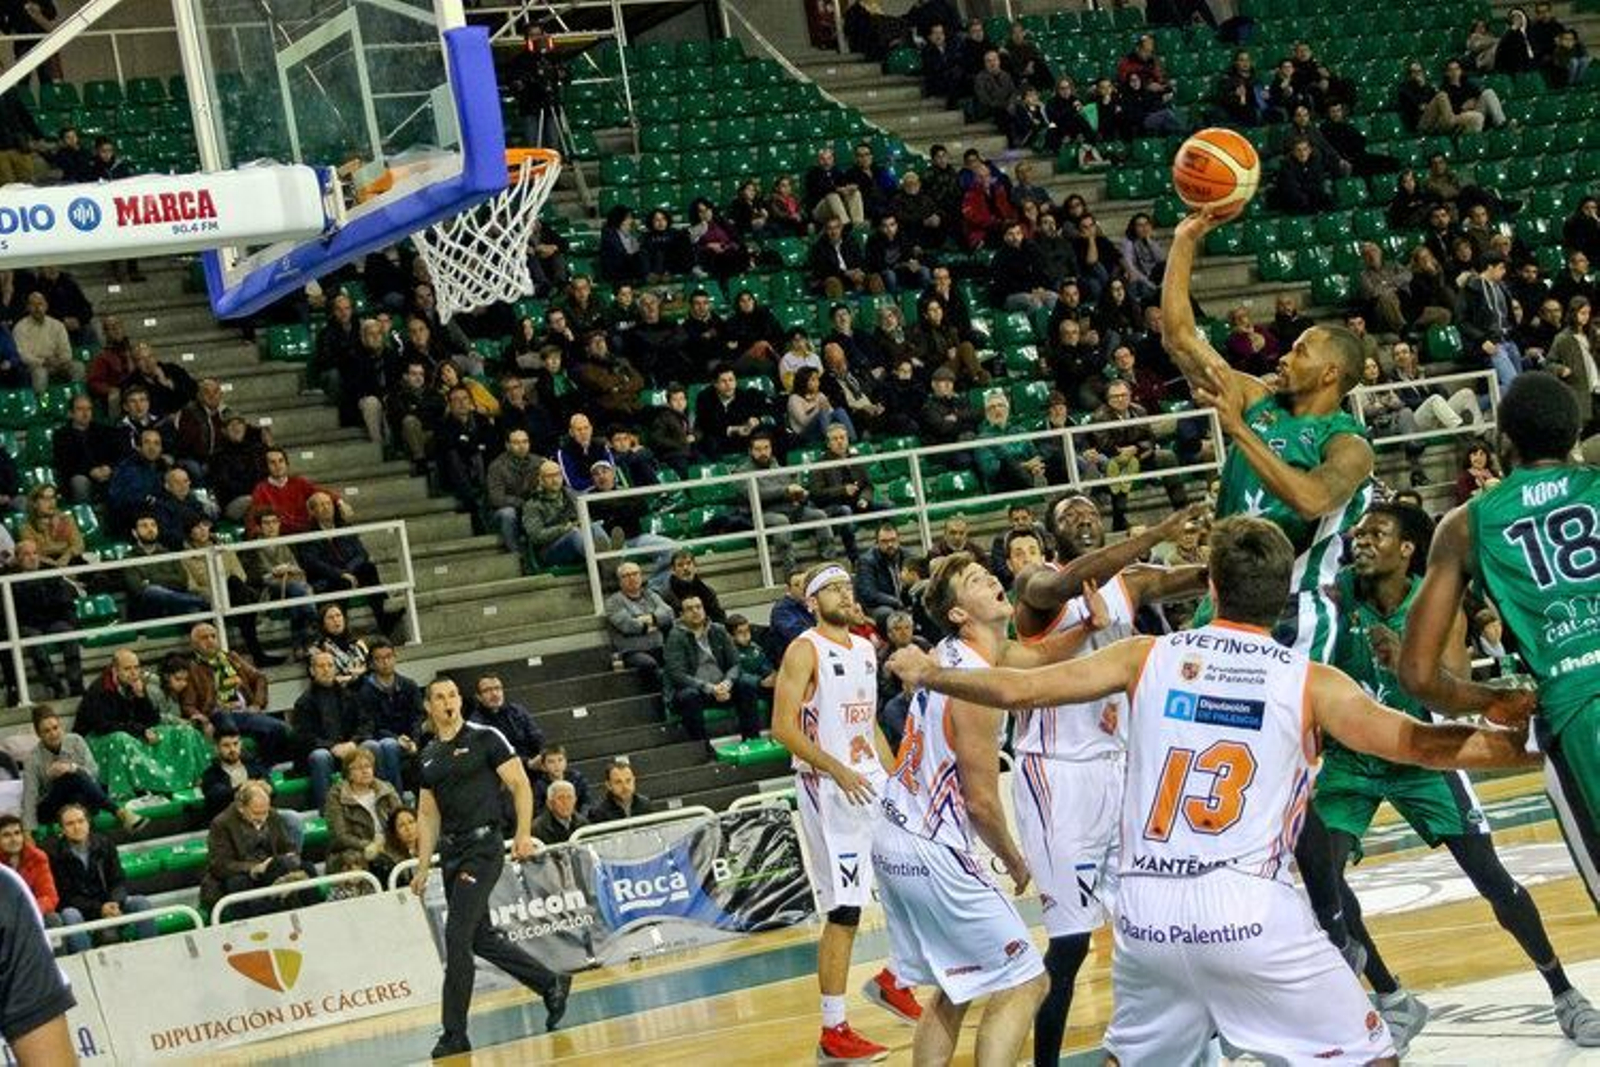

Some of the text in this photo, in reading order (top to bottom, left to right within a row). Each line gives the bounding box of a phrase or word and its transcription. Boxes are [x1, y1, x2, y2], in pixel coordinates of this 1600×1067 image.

[113, 188, 218, 227] MARCA
[172, 221, 220, 235] 90.4 FM
[1502, 503, 1600, 590] 18
[1142, 740, 1259, 843] 13
[612, 870, 688, 902] Roca
[1169, 921, 1263, 945] Palentino
[289, 1001, 318, 1021] DE
[322, 980, 413, 1014] CÁCERES
